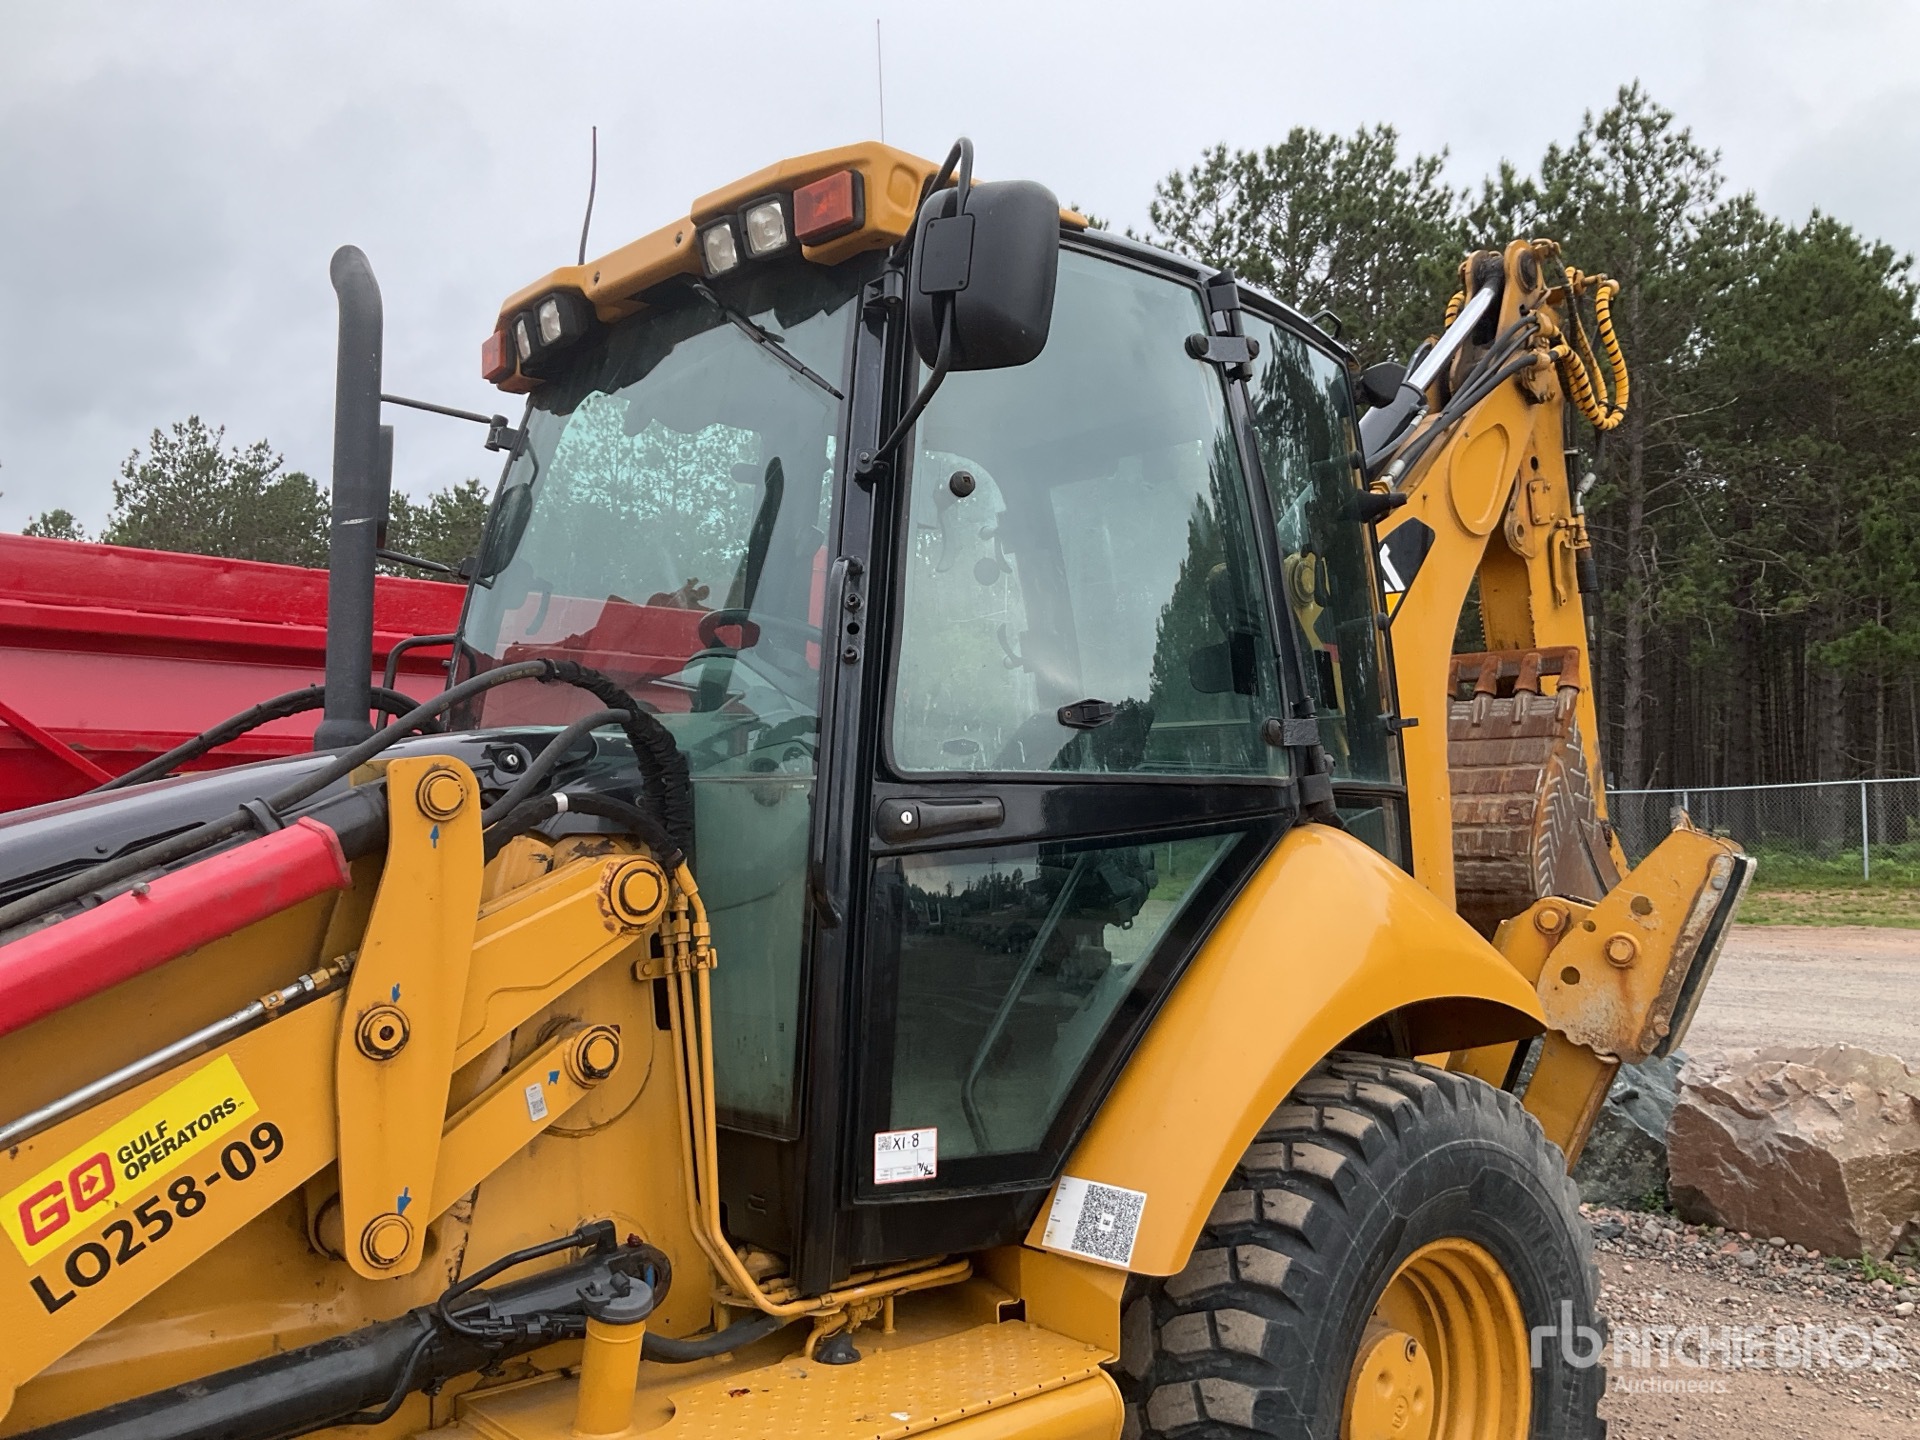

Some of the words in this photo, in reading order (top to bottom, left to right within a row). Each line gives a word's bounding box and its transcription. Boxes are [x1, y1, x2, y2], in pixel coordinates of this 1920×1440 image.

[117, 1120, 168, 1165] GULF
[124, 1097, 237, 1181] OPERATORS
[18, 1152, 116, 1247] GO
[29, 1121, 285, 1315] LO258-09
